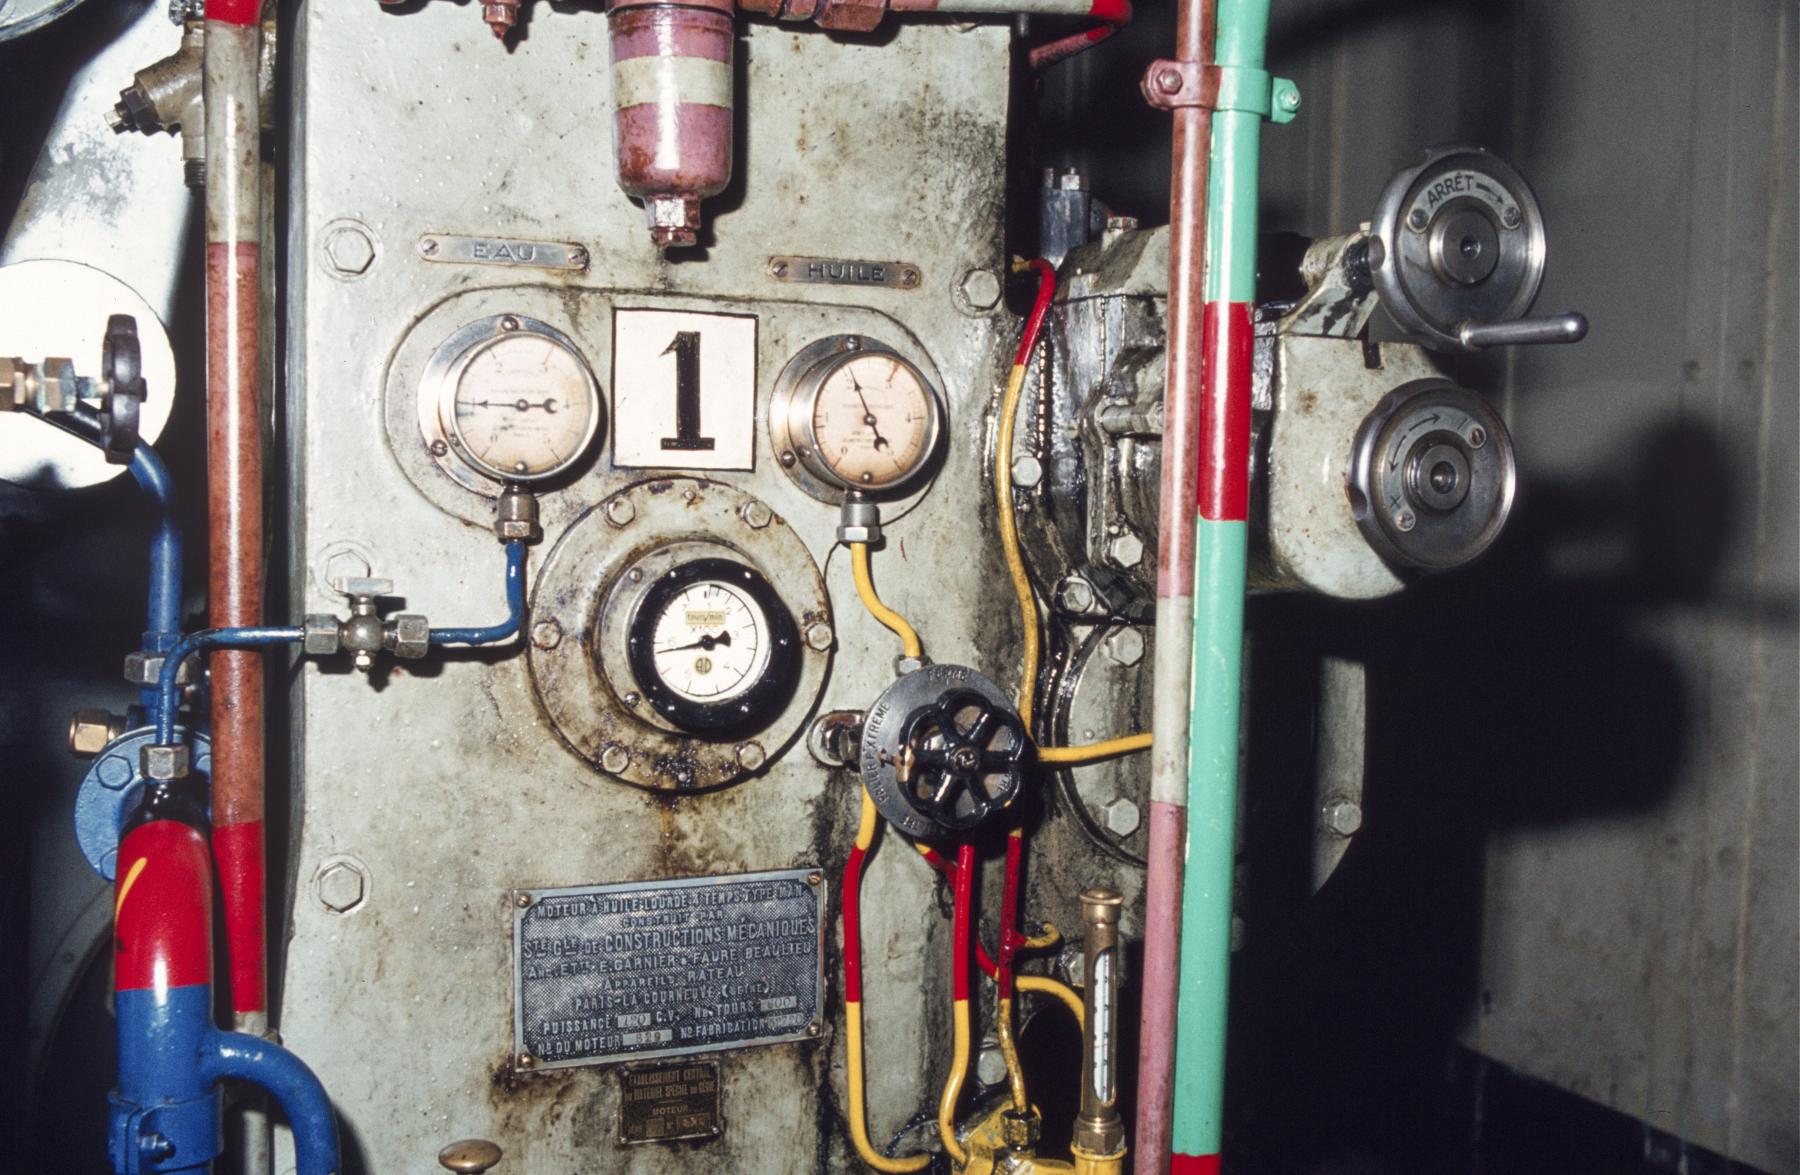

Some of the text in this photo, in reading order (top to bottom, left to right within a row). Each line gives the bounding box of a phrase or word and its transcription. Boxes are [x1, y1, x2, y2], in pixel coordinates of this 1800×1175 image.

[1427, 172, 1474, 208] ARRÊT
[472, 240, 536, 262] EAU
[808, 263, 887, 282] HUILE
[658, 331, 715, 450] 1
[537, 902, 587, 919] MOTEUR
[603, 899, 639, 914] HUILE
[644, 893, 688, 911] LOURDE
[705, 890, 741, 905] TEMPS
[743, 887, 773, 902] TYPE
[622, 909, 723, 929] CONSTRUIT PAR
[584, 940, 599, 955] DE
[605, 927, 722, 953] CONSTRUCTIONS
[727, 916, 817, 942] MÉCANIQUES
[693, 948, 738, 965] FAURE
[746, 941, 812, 960] BEAULIEU
[687, 965, 744, 983] RATEAU
[644, 983, 714, 1004] COURNEUVE
[543, 1016, 611, 1035] PUISSANCE
[717, 1000, 754, 1016] TOURS
[556, 1040, 571, 1055] DU
[575, 1034, 620, 1051] MOTEUR
[696, 1017, 765, 1037] FABRICATION
